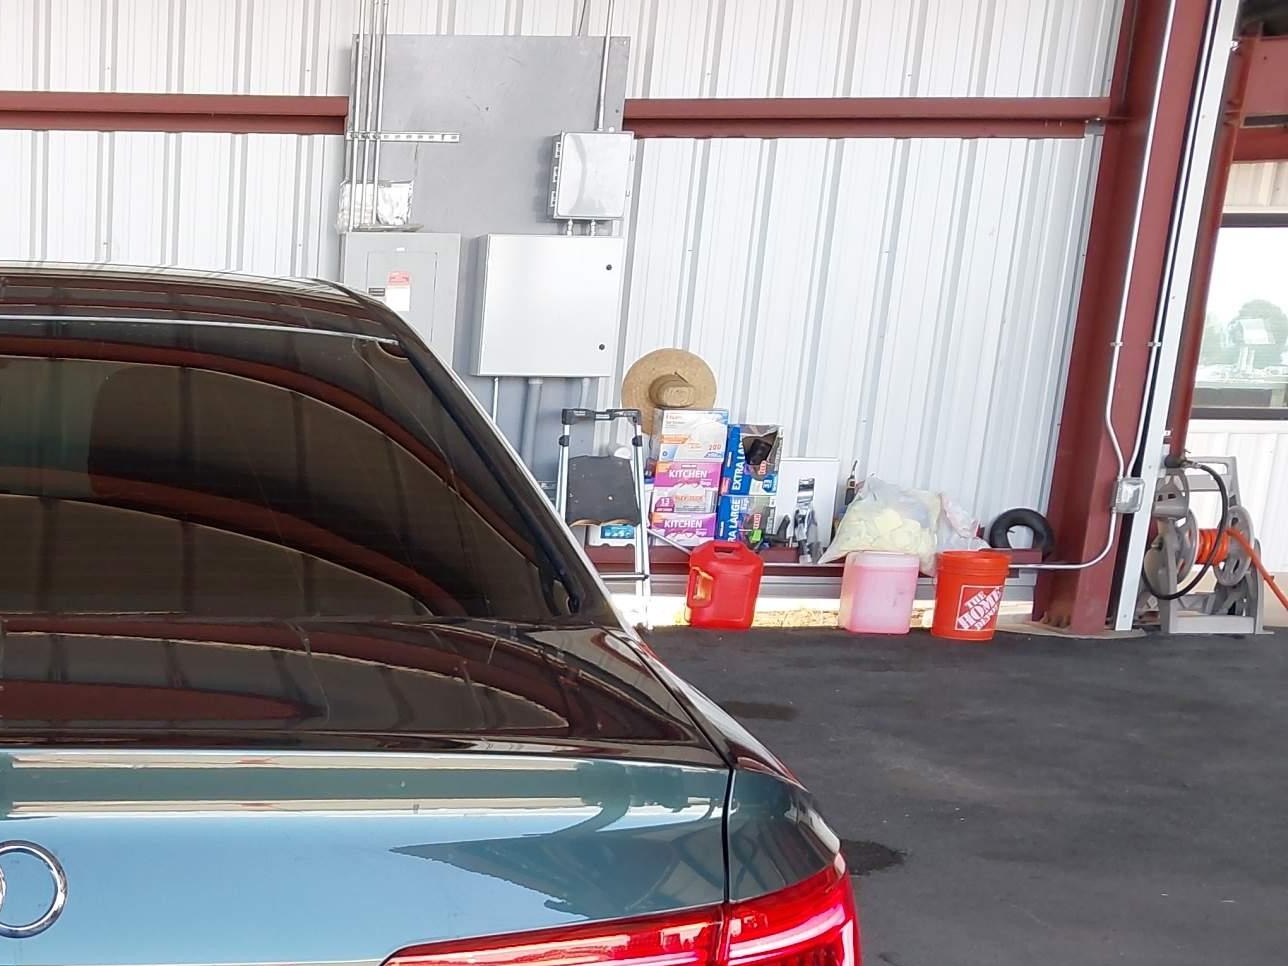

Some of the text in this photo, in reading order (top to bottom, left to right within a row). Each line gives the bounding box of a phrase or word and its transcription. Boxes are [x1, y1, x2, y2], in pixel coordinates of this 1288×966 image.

[669, 470, 708, 478] KITCHEN
[732, 461, 745, 490] EXTRA
[664, 520, 703, 528] KITCHEN
[728, 499, 740, 529] LARGE
[958, 586, 1002, 629] HOME
[964, 590, 987, 608] THE
